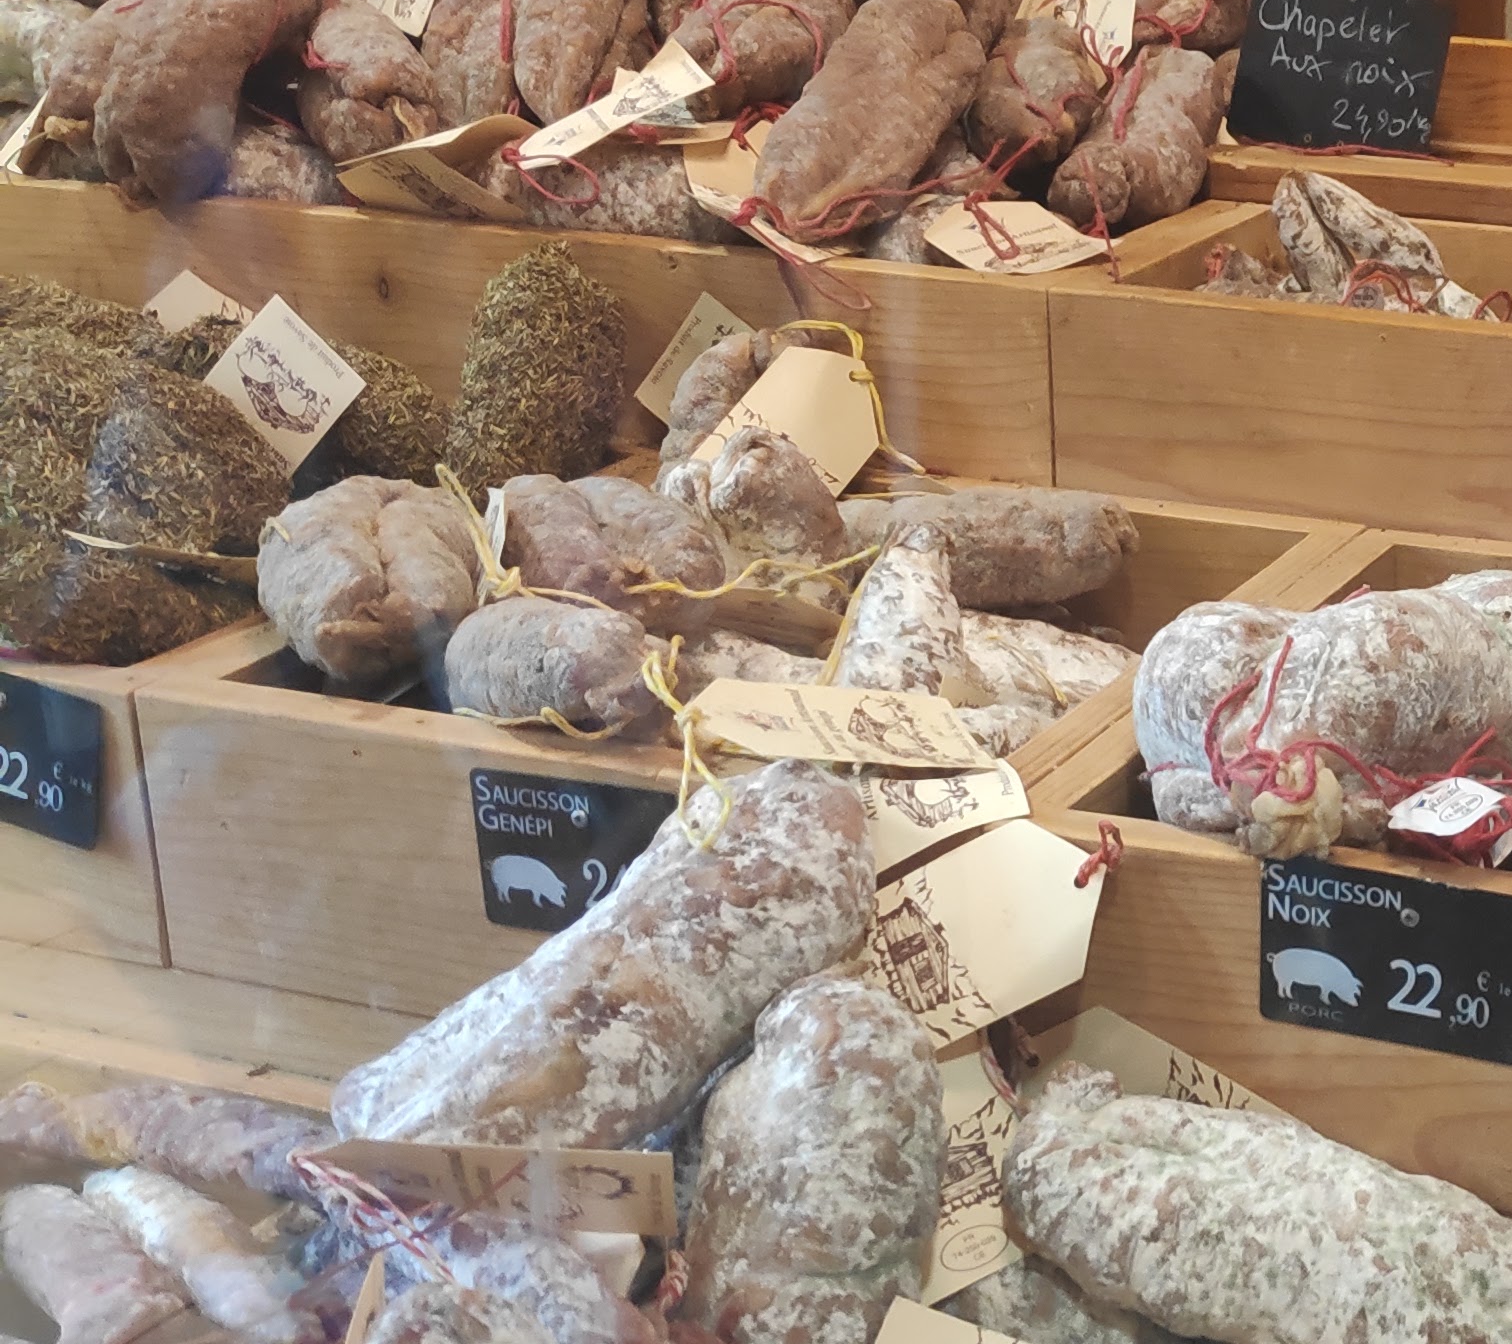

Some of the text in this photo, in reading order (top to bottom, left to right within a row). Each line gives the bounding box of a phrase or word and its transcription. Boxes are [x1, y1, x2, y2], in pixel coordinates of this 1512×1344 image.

[478, 804, 553, 838] GENÉPI
[1268, 864, 1402, 911] SAUCISSON
[1268, 892, 1331, 929] NOIX
[1477, 971, 1491, 992] €
[1288, 1003, 1344, 1022] PORC
